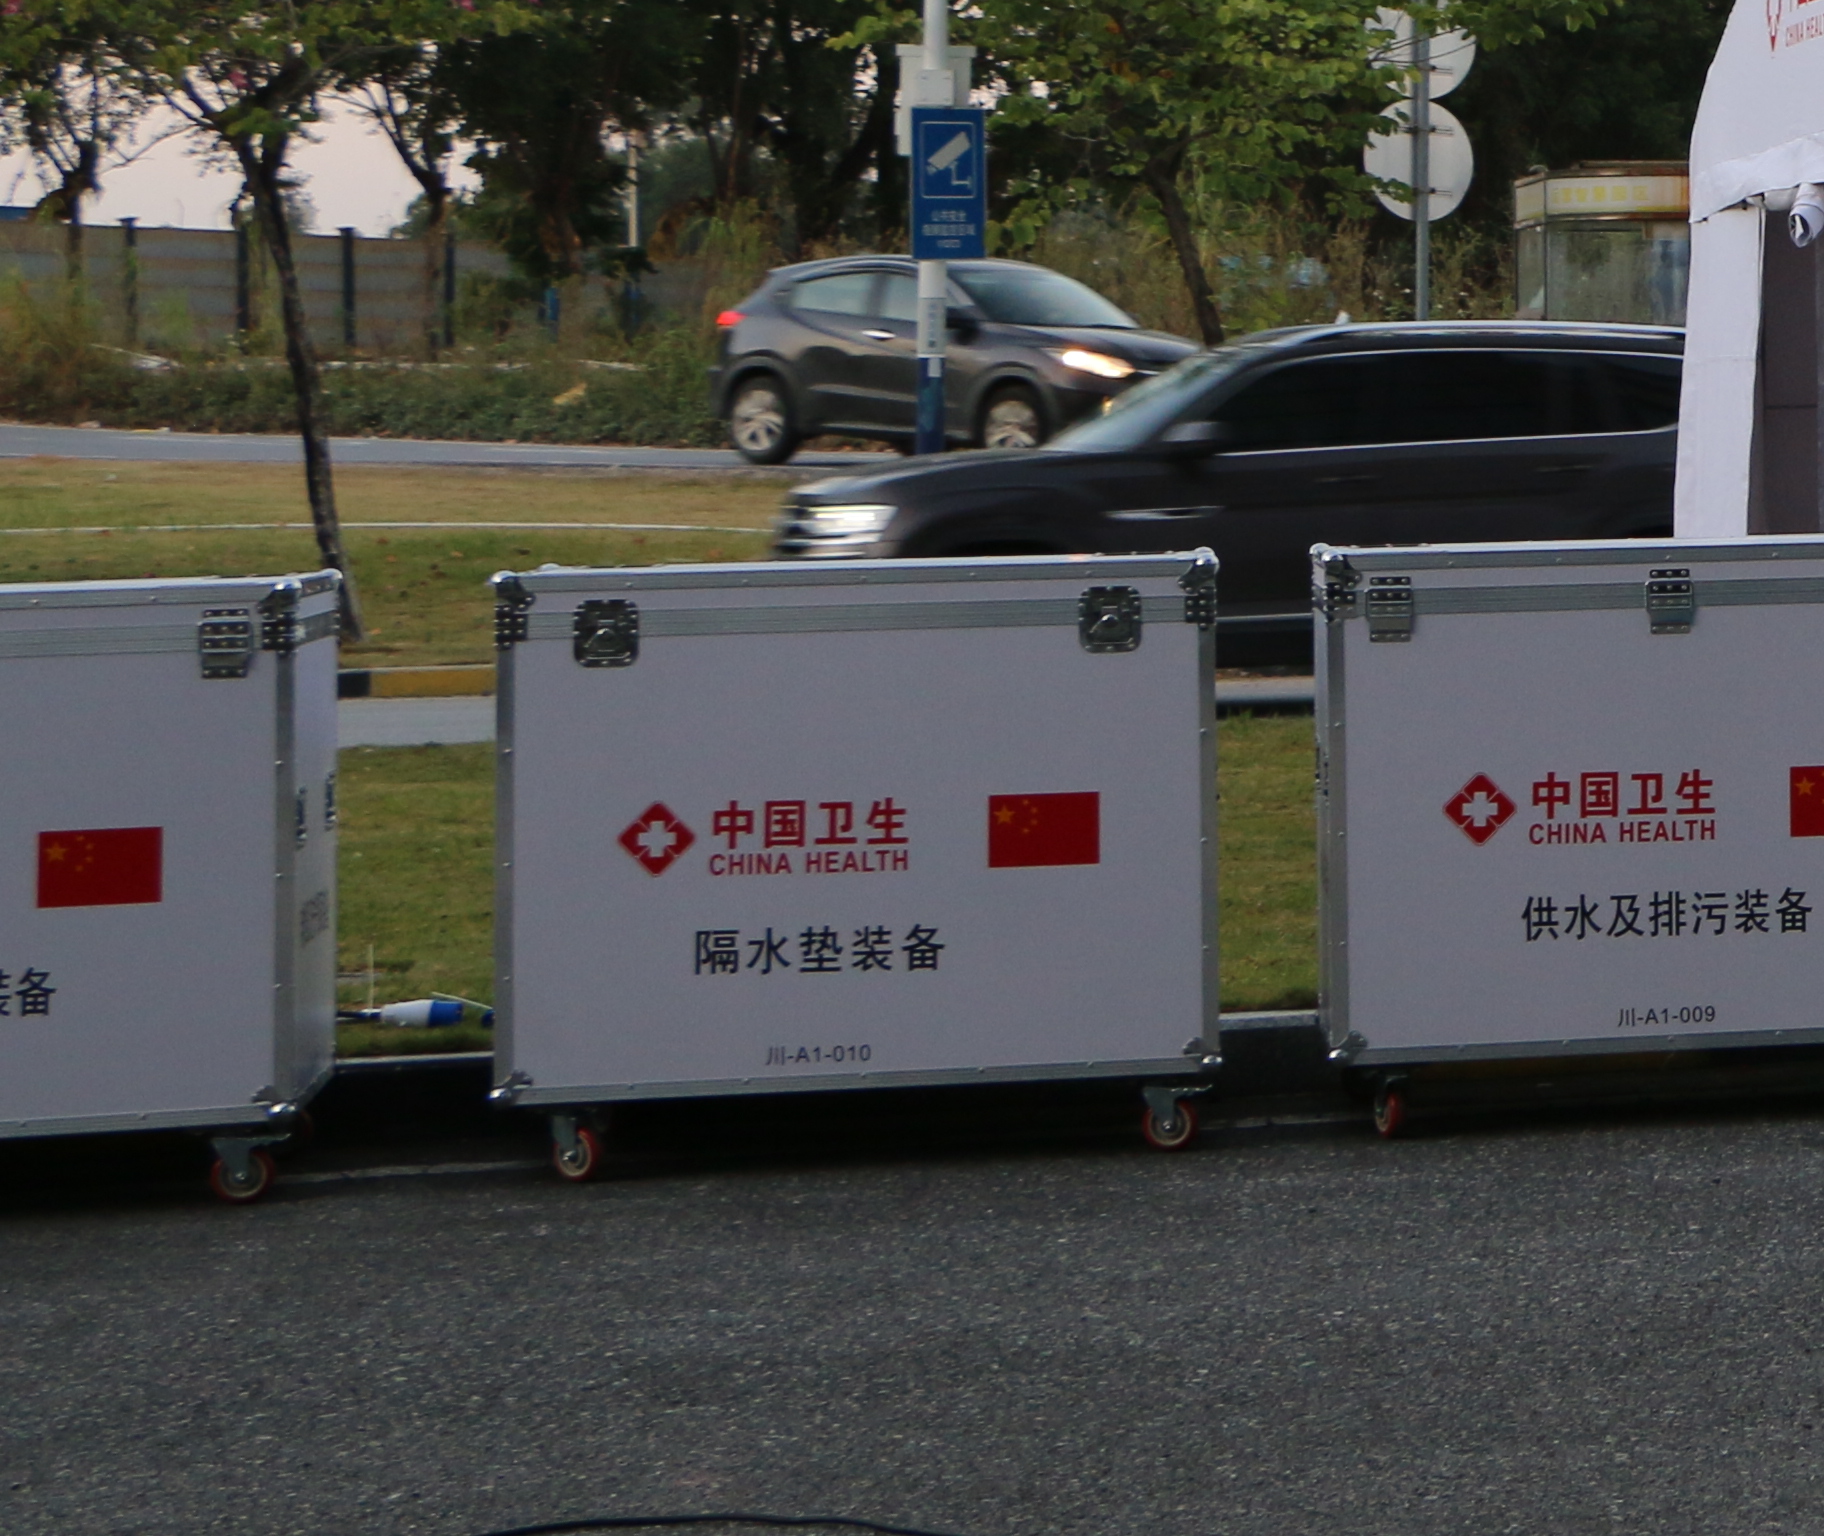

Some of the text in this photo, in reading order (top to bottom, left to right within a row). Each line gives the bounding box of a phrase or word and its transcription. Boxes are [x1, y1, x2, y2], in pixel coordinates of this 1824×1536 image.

[1531, 769, 1716, 820] 中国卫生
[711, 799, 910, 850] 中国卫生
[1530, 819, 1716, 845] CHINA HEALTH
[711, 849, 909, 876] CHINA HEALTH
[1522, 887, 1812, 941] 供水及排污装备
[695, 924, 945, 975] 隔水垫装备
